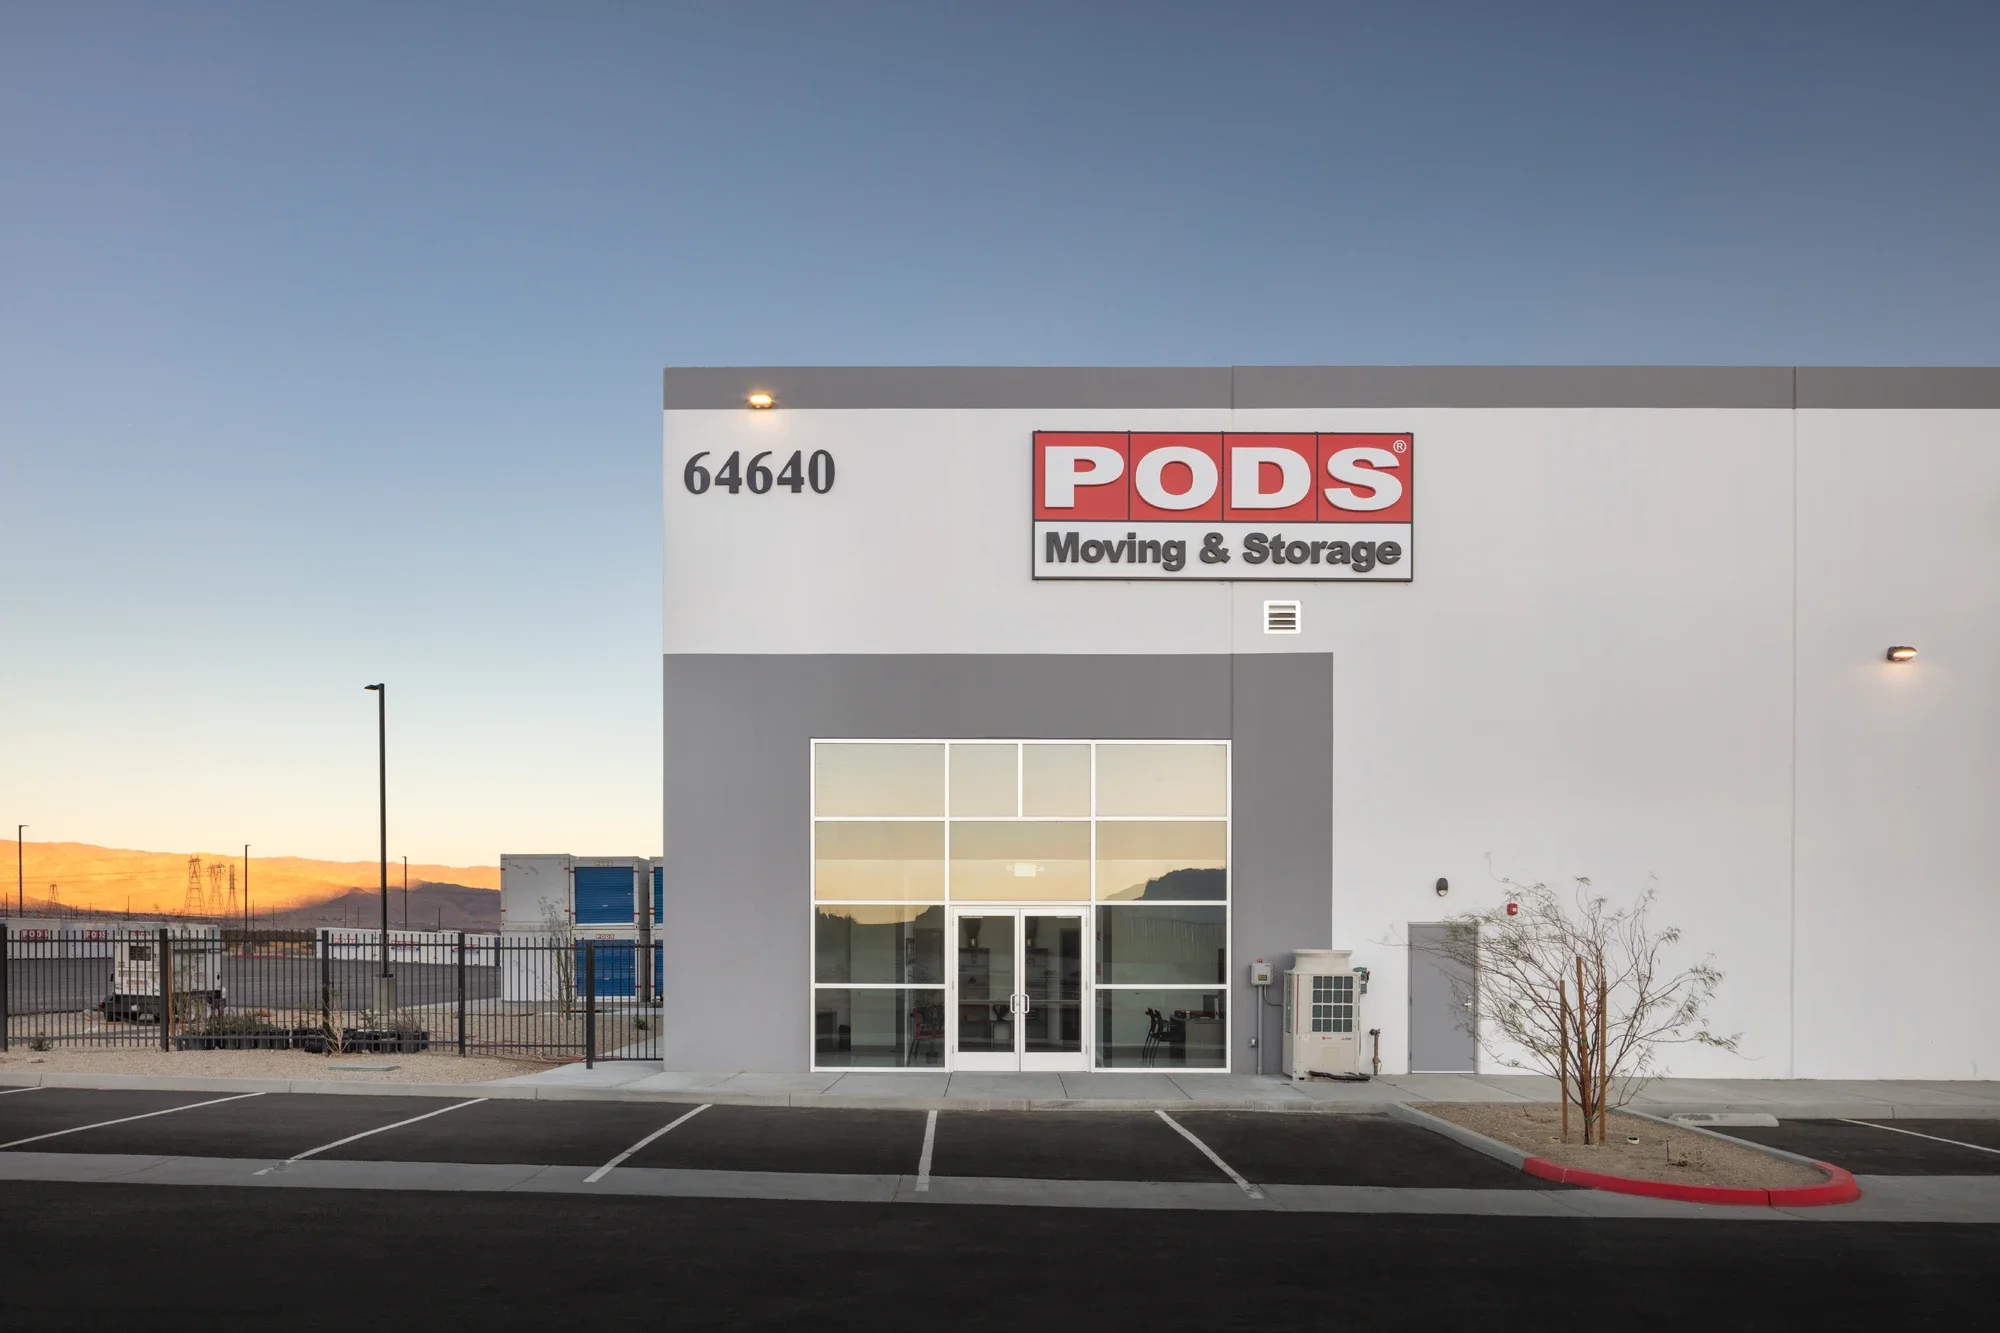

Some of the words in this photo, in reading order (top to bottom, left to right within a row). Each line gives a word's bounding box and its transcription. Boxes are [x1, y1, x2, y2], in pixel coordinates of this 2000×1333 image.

[684, 449, 836, 495] 64640
[1045, 531, 1187, 572] Moving
[1199, 532, 1231, 564] &
[1242, 532, 1402, 573] Storage
